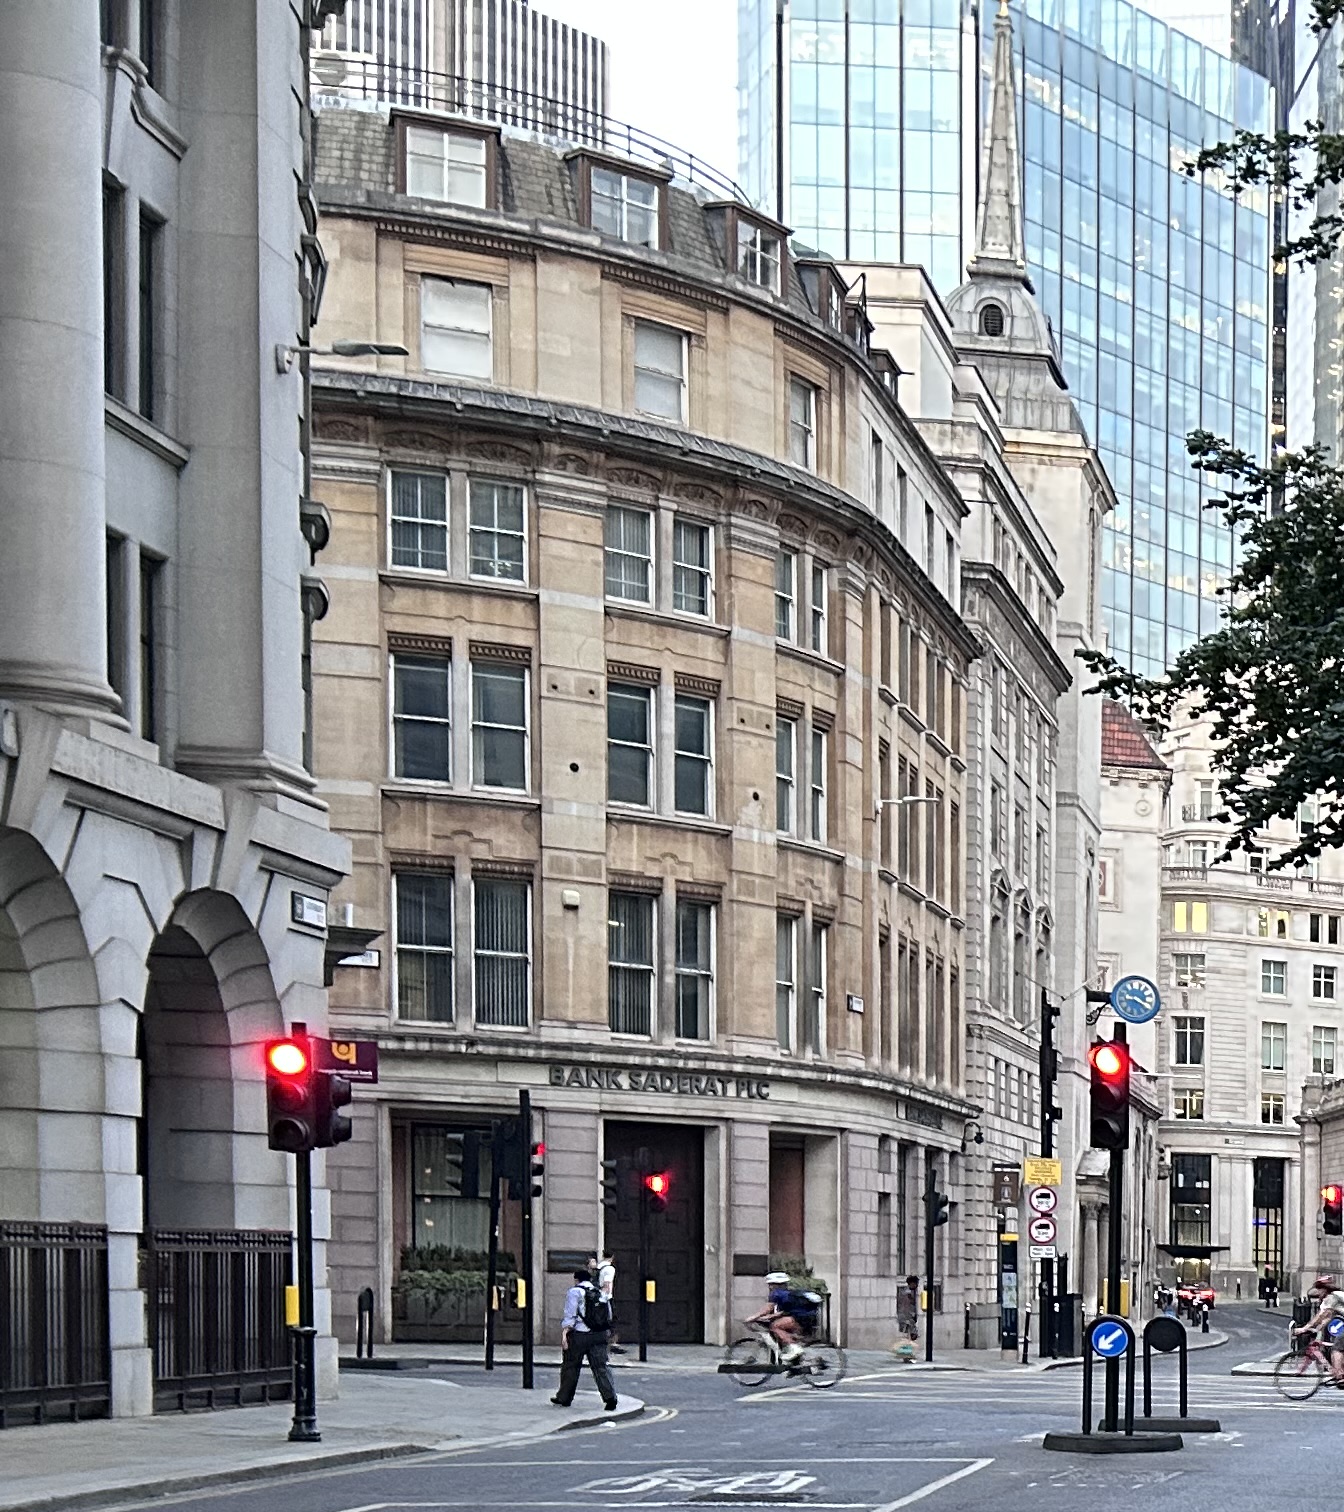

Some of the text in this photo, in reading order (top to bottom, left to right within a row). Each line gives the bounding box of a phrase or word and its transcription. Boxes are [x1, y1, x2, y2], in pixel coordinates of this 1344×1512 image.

[550, 1065, 770, 1099] BANK SADERAT PLC
